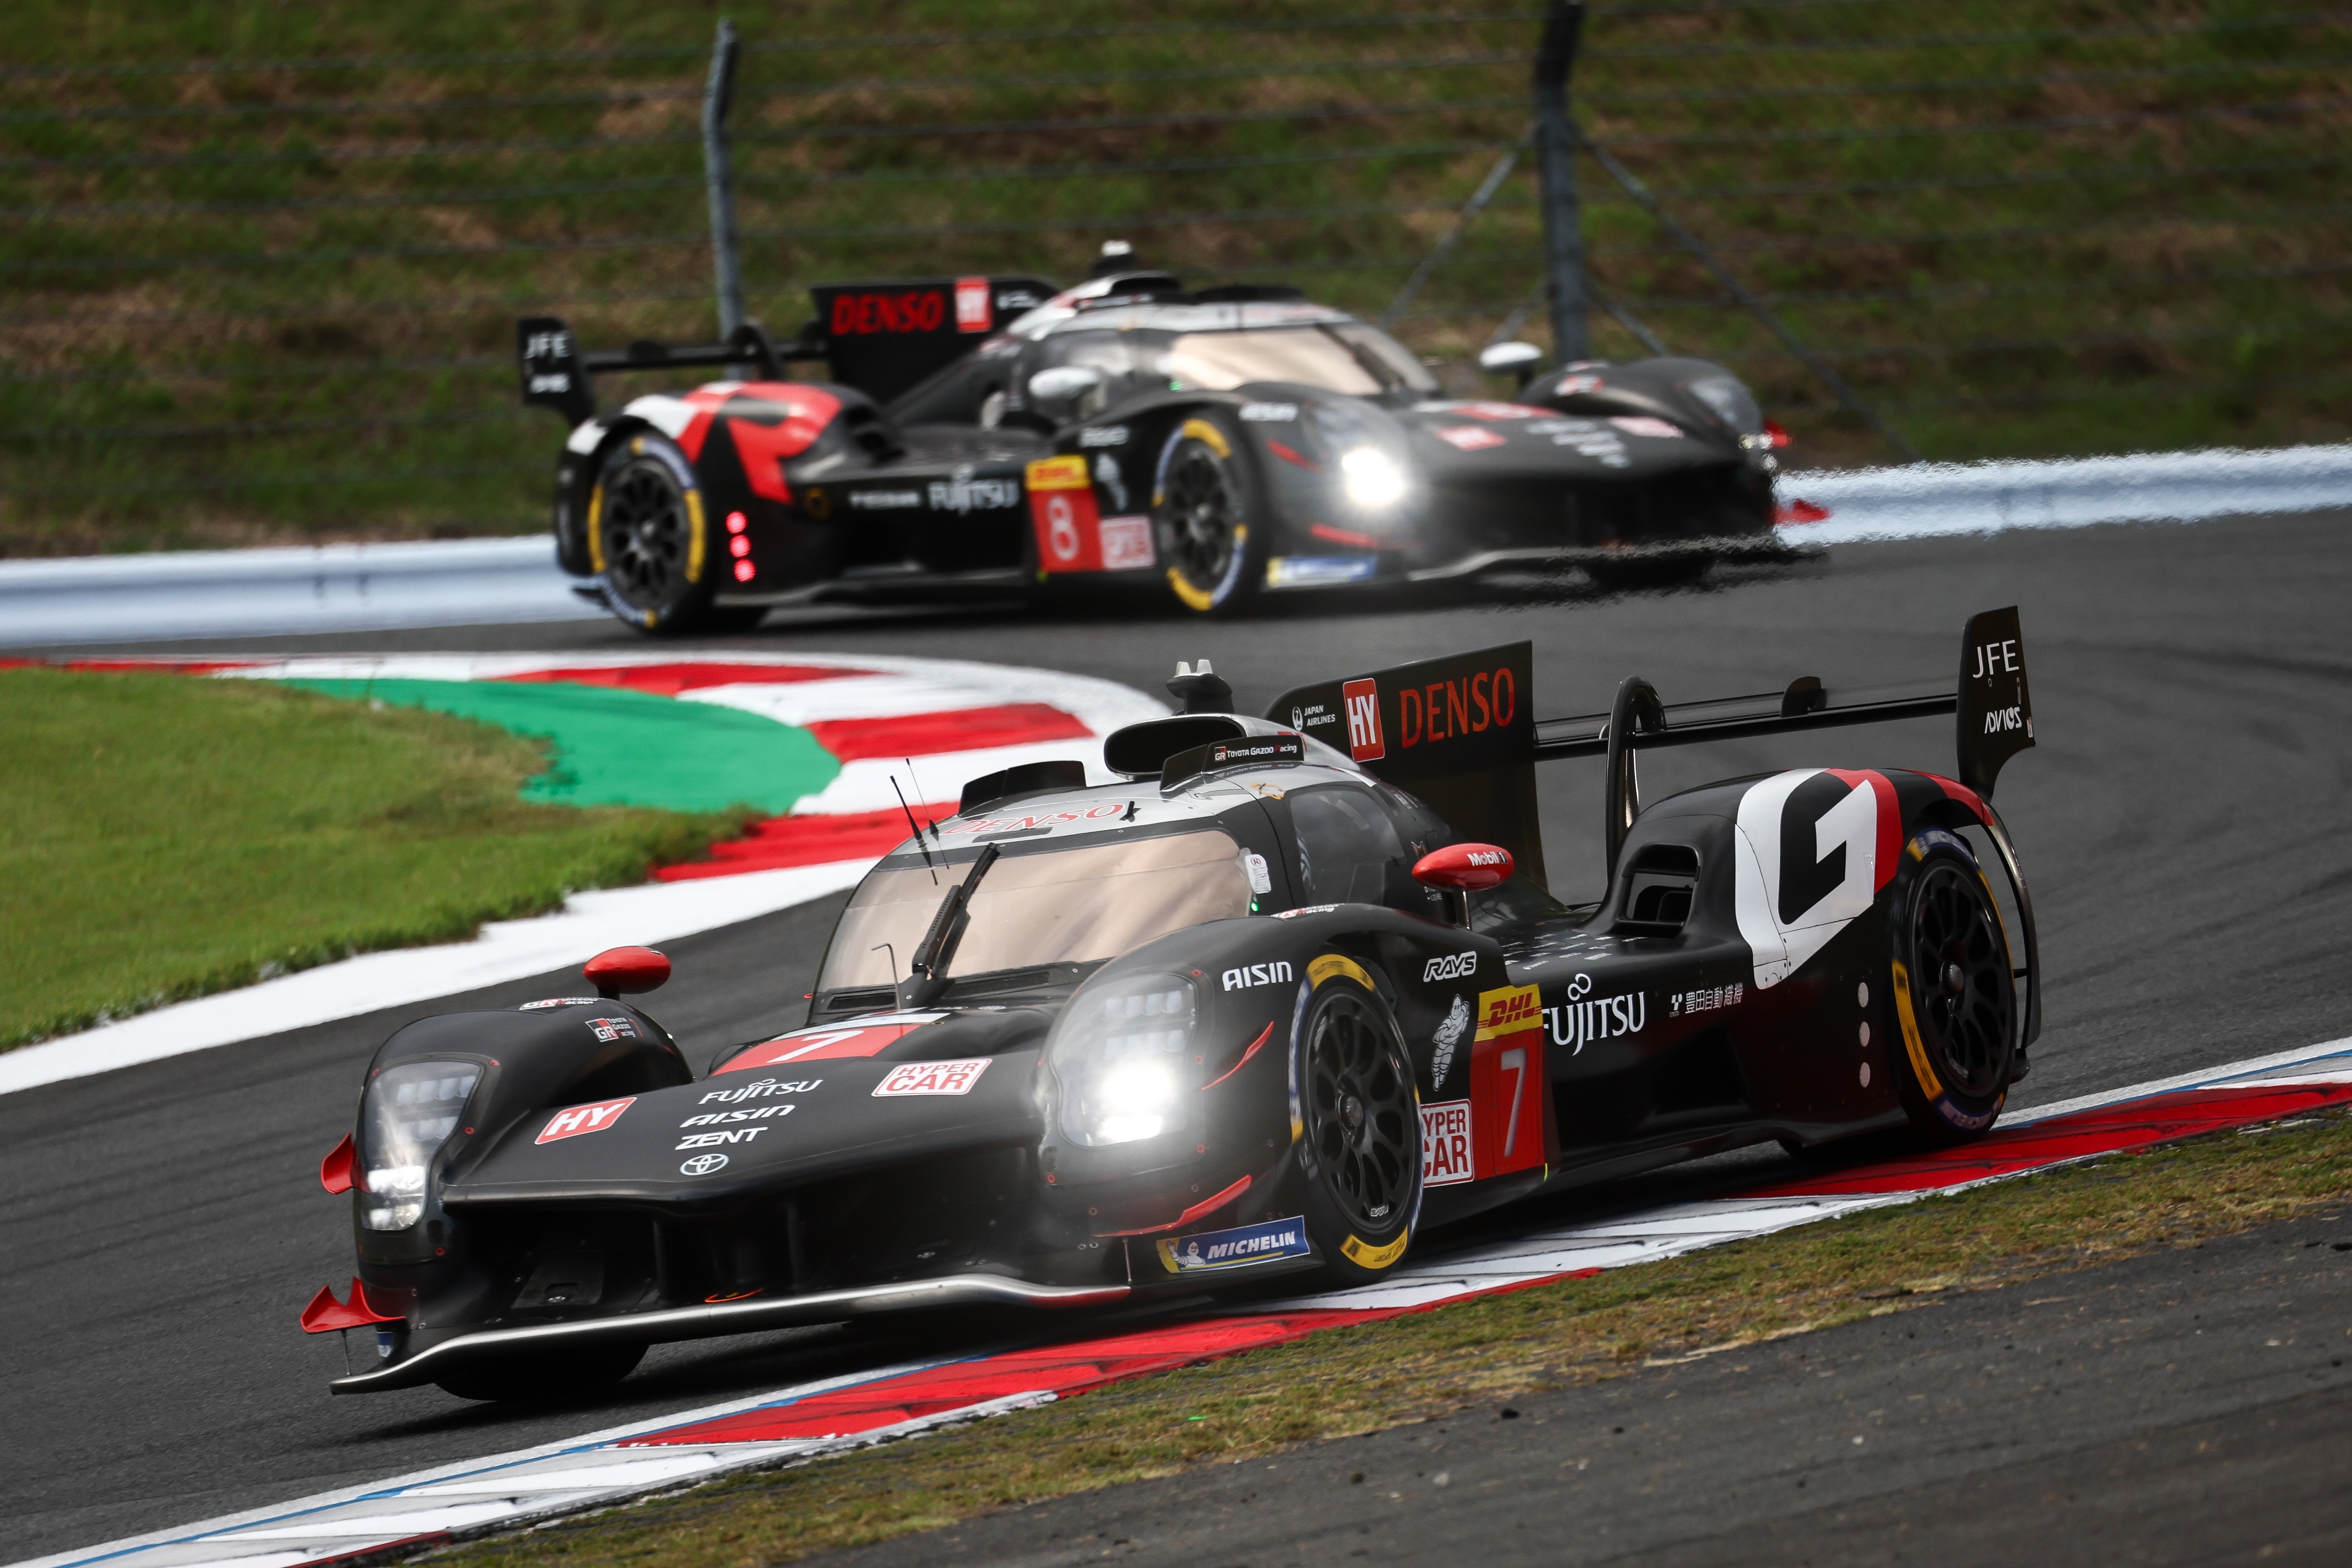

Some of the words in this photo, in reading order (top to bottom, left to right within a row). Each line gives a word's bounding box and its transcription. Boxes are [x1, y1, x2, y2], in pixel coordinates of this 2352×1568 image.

[832, 291, 945, 335] DENSO
[1048, 496, 1079, 561] 8
[1972, 640, 2019, 678] JFE
[1304, 705, 1324, 716] JAPAN
[1307, 714, 1336, 726] AIRLINES
[1347, 694, 1376, 747] HY
[1399, 667, 1515, 748] DENSO
[1227, 749, 1249, 757] TOYOTA
[1250, 746, 1274, 755] GAZOO
[1275, 744, 1297, 753] Racing
[942, 804, 1126, 836] DENSO
[1467, 852, 1499, 866] Mobil
[1499, 852, 1505, 862] 1
[1222, 962, 1292, 992] AISIN
[1423, 951, 1477, 982] RAYS
[1488, 992, 1535, 1027] DHL
[594, 1026, 618, 1039] GR
[766, 1030, 864, 1063] 7
[887, 1073, 970, 1092] CAR
[898, 1062, 980, 1076] HYPER
[697, 1079, 823, 1104] FUJITSU
[1501, 1047, 1528, 1157] 7
[545, 1103, 626, 1136] HY
[679, 1105, 796, 1128] AISIN
[1422, 1109, 1467, 1137] YPER
[675, 1127, 769, 1150] ZENT
[1208, 1231, 1296, 1259] MICHELIN
